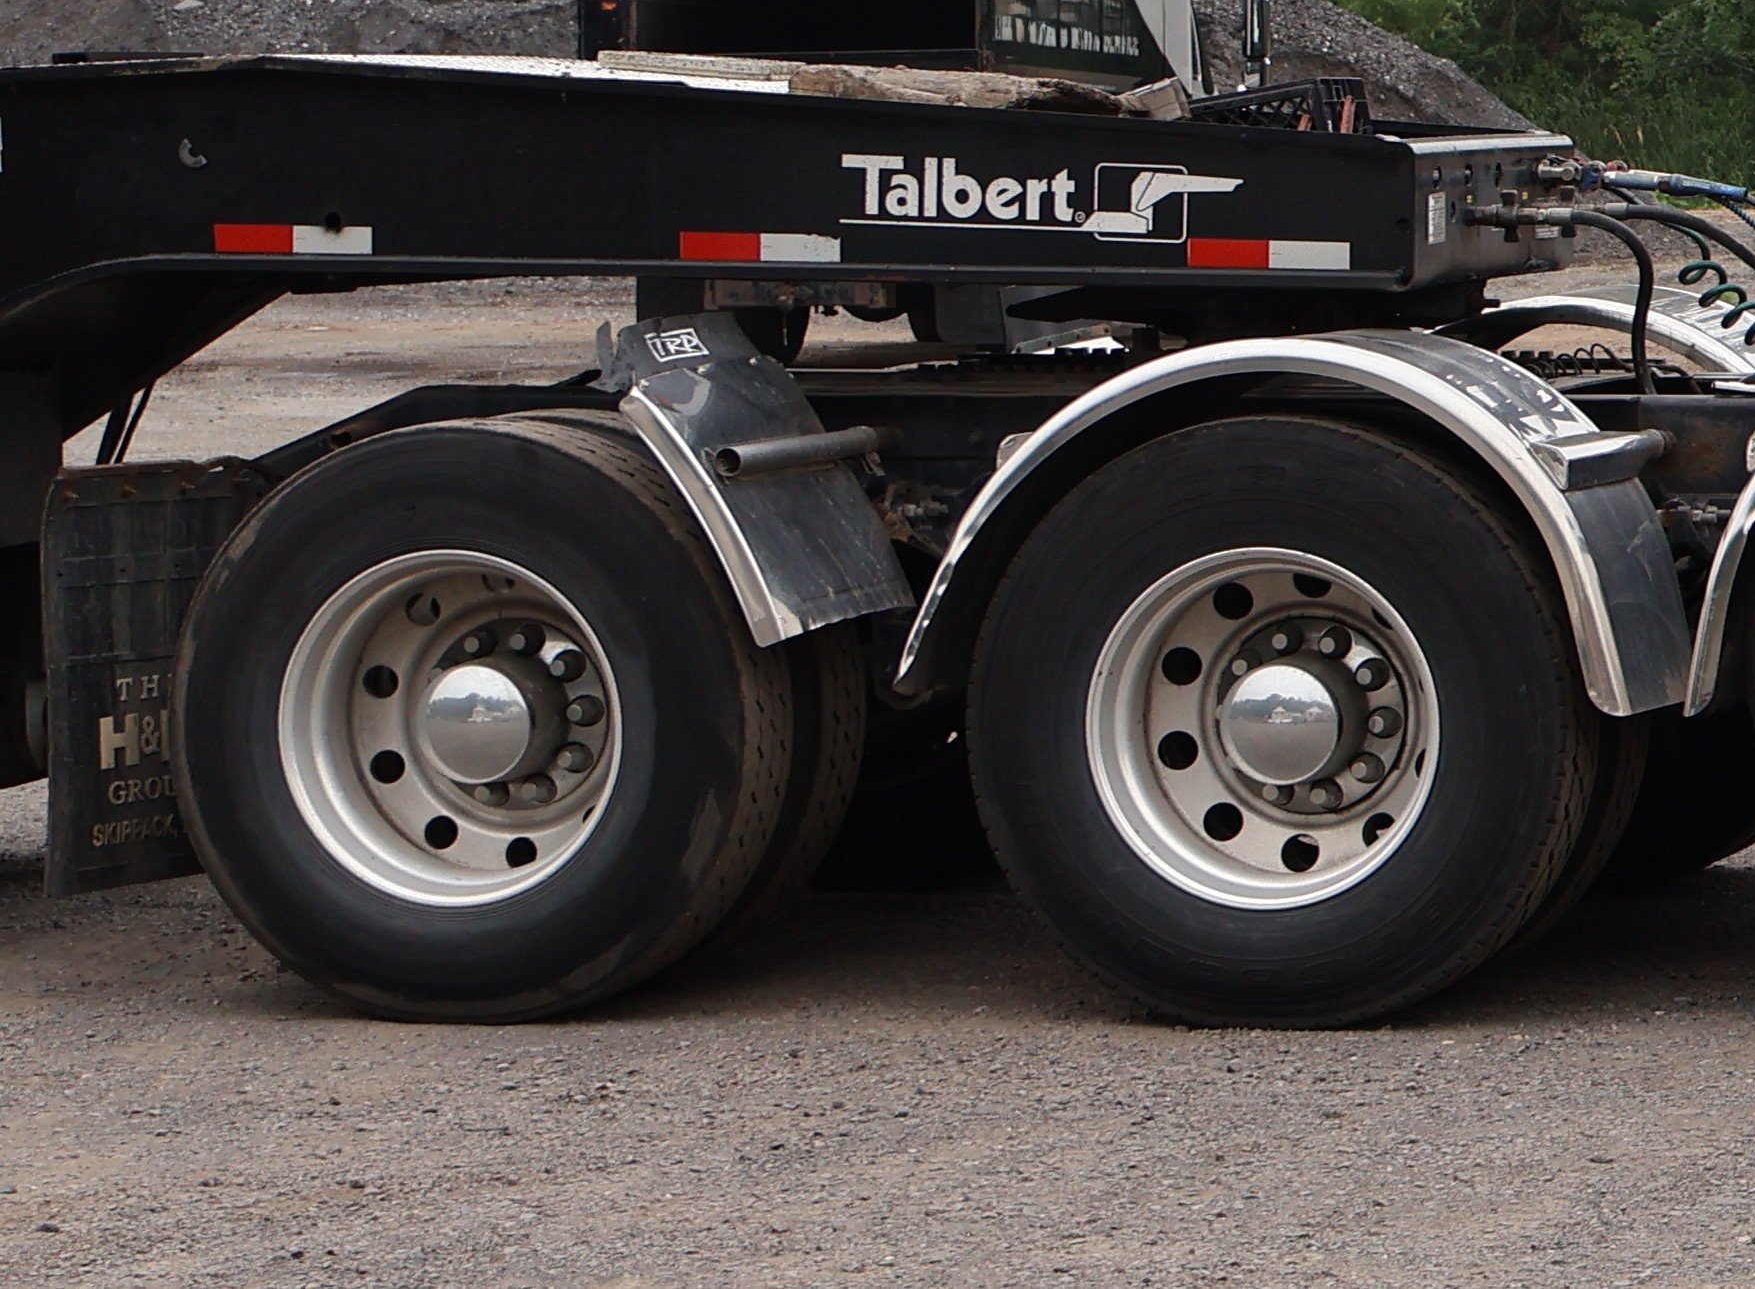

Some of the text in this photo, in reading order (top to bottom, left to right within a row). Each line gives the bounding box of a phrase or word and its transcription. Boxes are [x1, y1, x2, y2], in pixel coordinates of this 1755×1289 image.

[841, 153, 1076, 223] Talbert
[116, 674, 173, 702] TH
[108, 774, 177, 805] GROU
